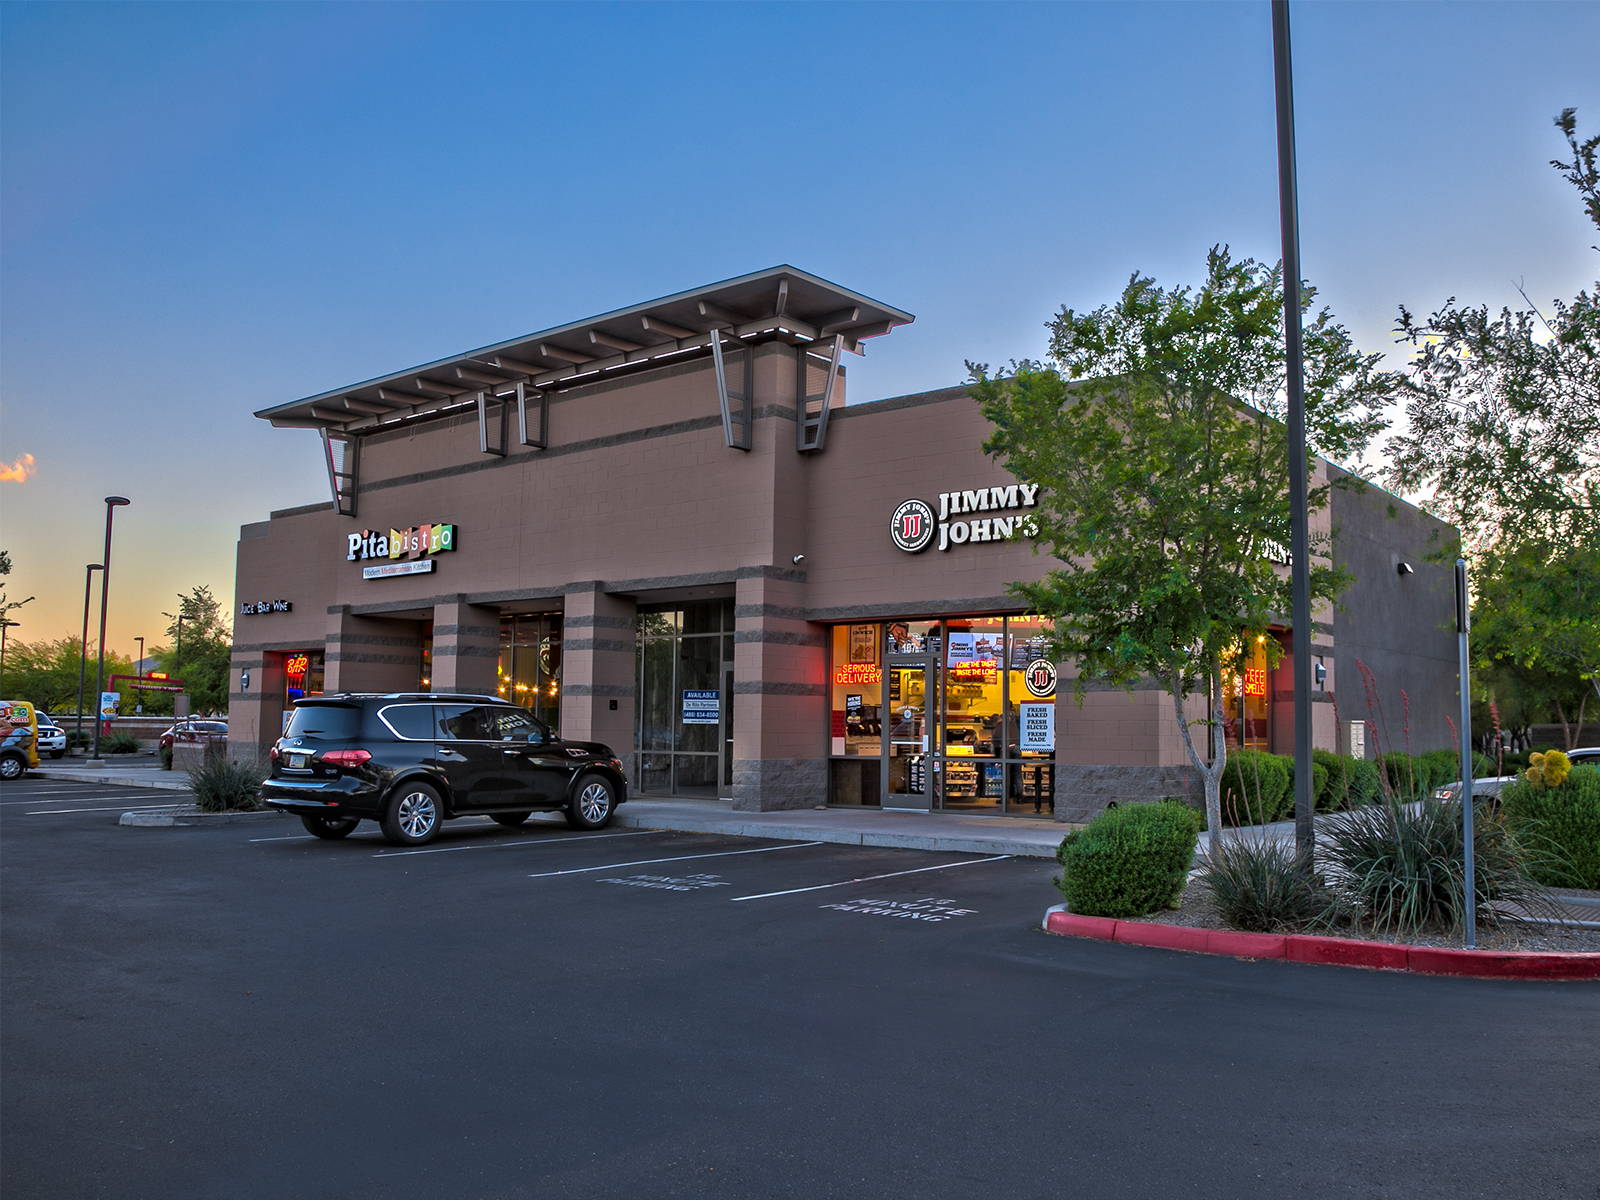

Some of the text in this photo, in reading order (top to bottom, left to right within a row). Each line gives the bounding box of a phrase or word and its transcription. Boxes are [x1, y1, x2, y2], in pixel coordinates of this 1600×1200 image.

[938, 483, 1039, 521] JIMMY
[894, 504, 911, 527] JIMMY
[902, 514, 921, 539] JJ
[287, 657, 307, 673] BAR
[842, 663, 876, 673] SERIOUS
[836, 673, 882, 684] DELIVERY
[1244, 683, 1265, 695] SMELLS
[818, 903, 951, 922] PARKING
